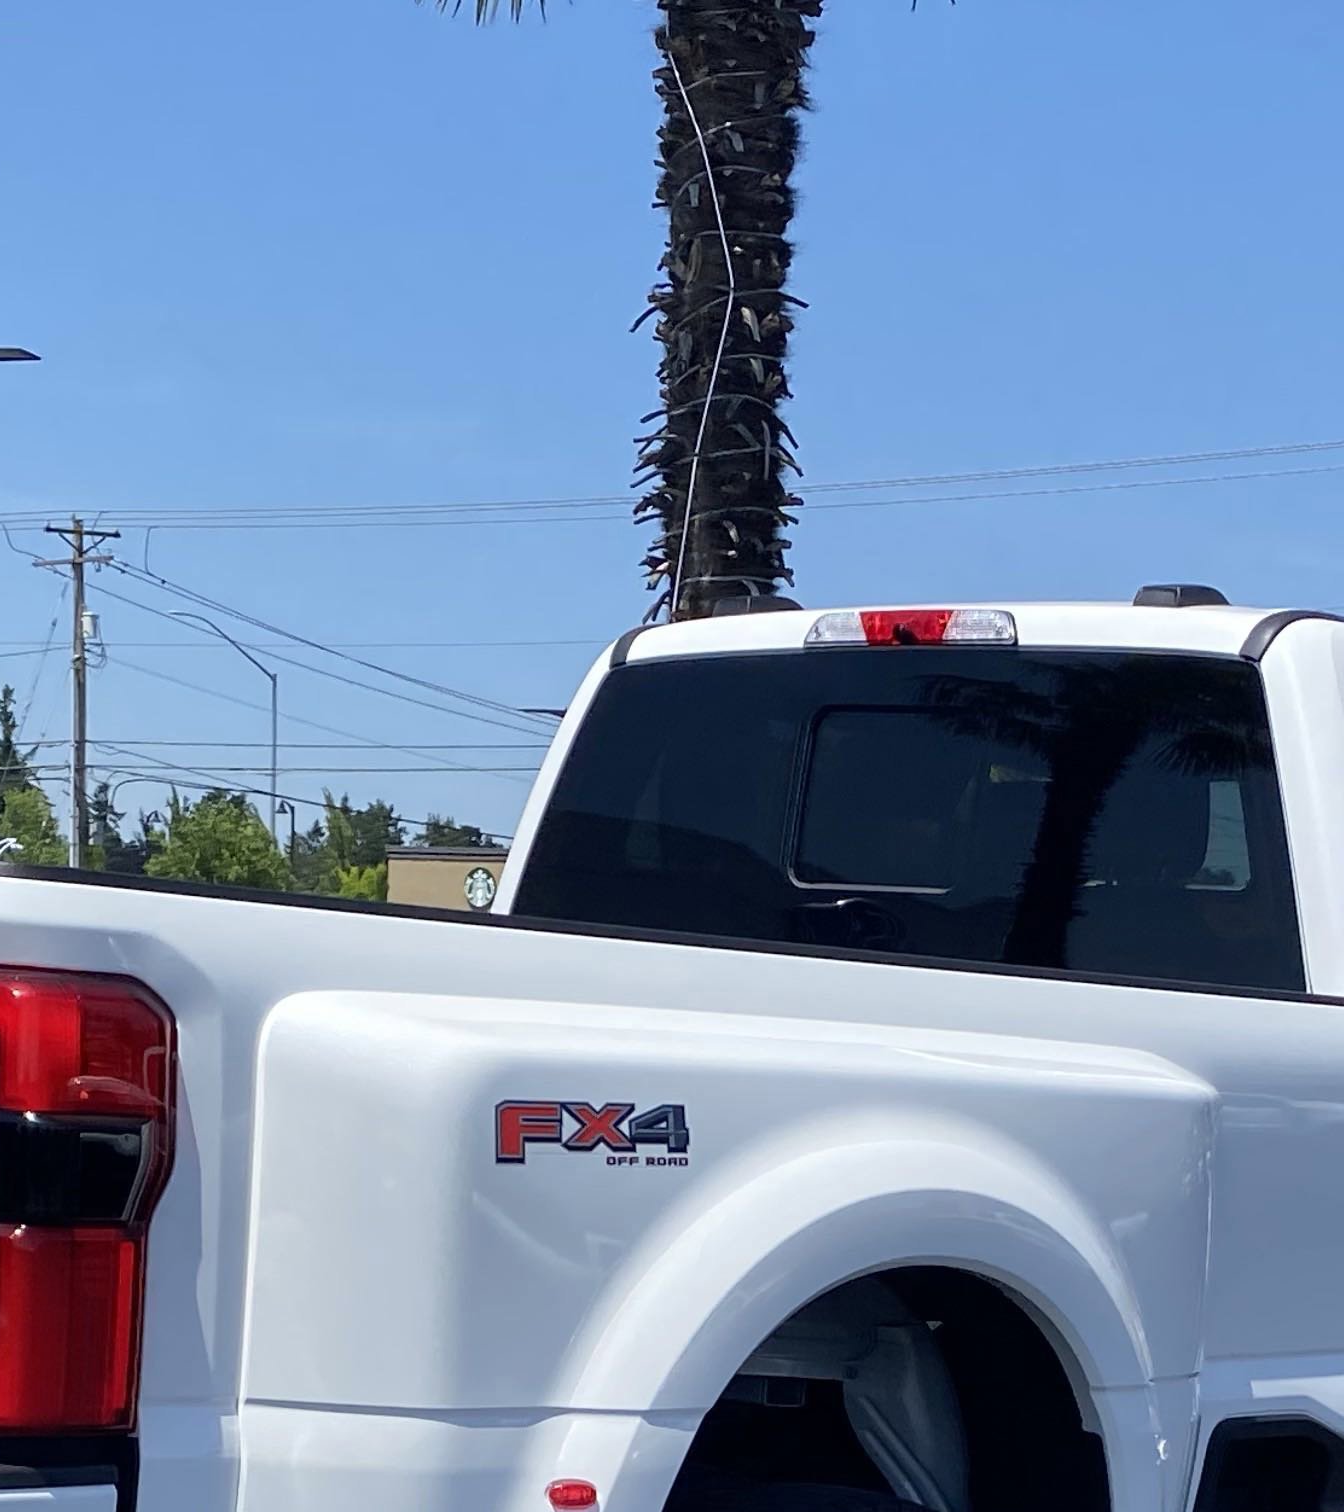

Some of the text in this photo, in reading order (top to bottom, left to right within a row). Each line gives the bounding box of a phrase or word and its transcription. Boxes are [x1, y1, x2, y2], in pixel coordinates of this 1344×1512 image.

[495, 1099, 690, 1164] FX4
[606, 1156, 689, 1166] OFF ROAD
